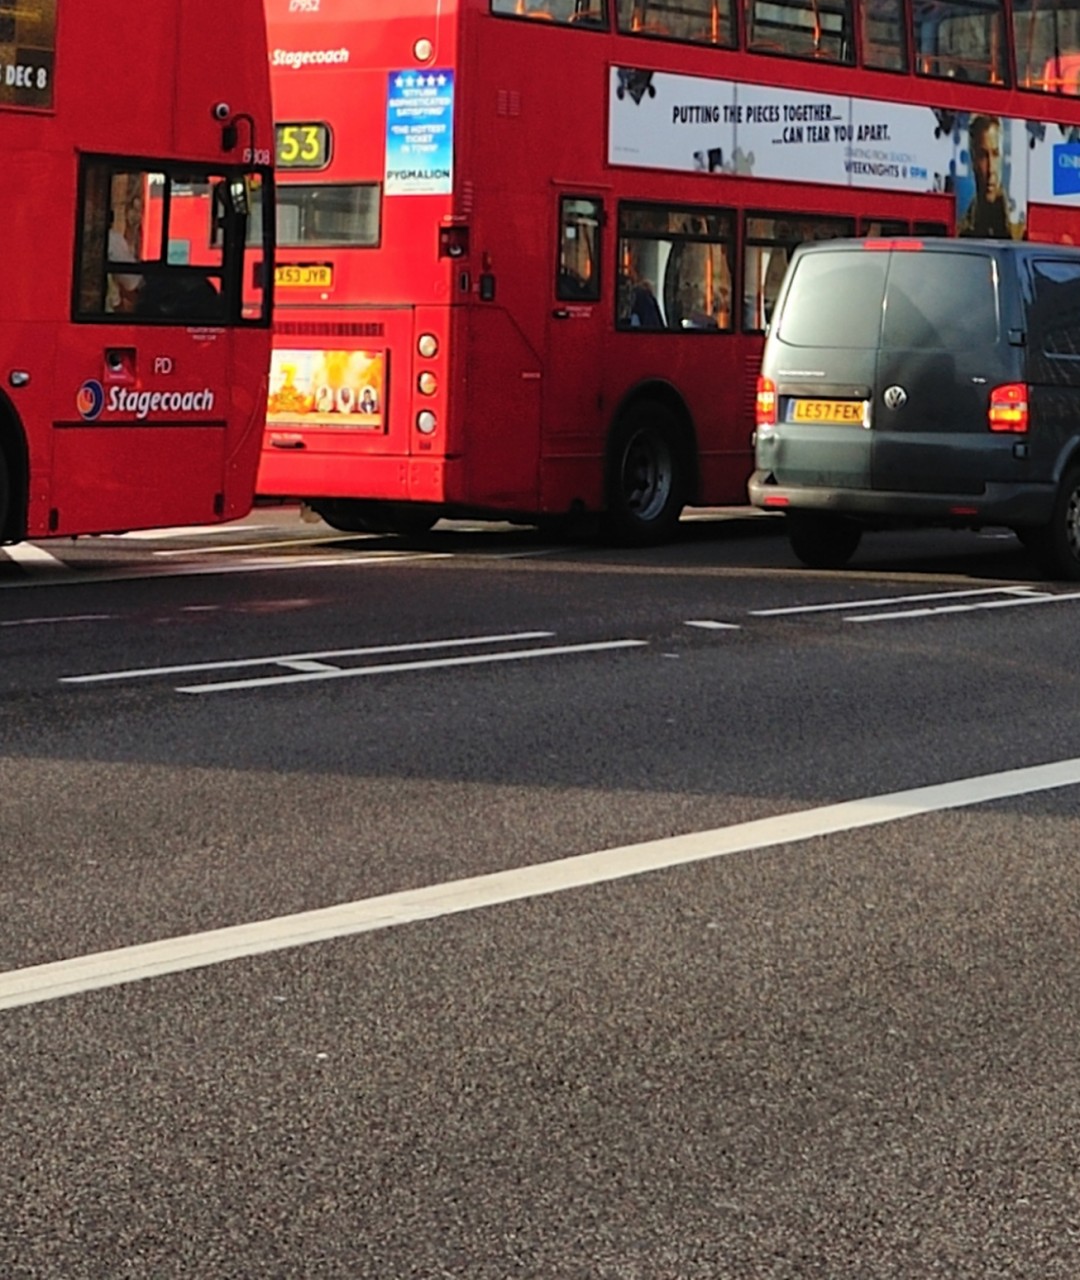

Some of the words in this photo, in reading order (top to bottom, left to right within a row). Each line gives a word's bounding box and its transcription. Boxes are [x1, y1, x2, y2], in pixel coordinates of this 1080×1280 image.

[272, 49, 349, 69] Stagecoach
[5, 65, 33, 88] DEC
[36, 67, 48, 89] 8
[672, 105, 720, 124] PUTTING
[724, 105, 742, 123] THE
[746, 105, 780, 124] PIECES
[806, 125, 830, 143] TEAR
[834, 124, 853, 143] YOU
[857, 124, 891, 142] APART.
[281, 126, 320, 161] 53
[387, 169, 450, 180] PYGMALION
[844, 161, 900, 178] WEEKNIGHTS
[276, 268, 301, 283] X53
[303, 268, 328, 283] JYR
[155, 357, 173, 375] PD
[107, 385, 215, 420] Stagecoach
[797, 402, 831, 419] LE57
[835, 404, 862, 421] FEK
